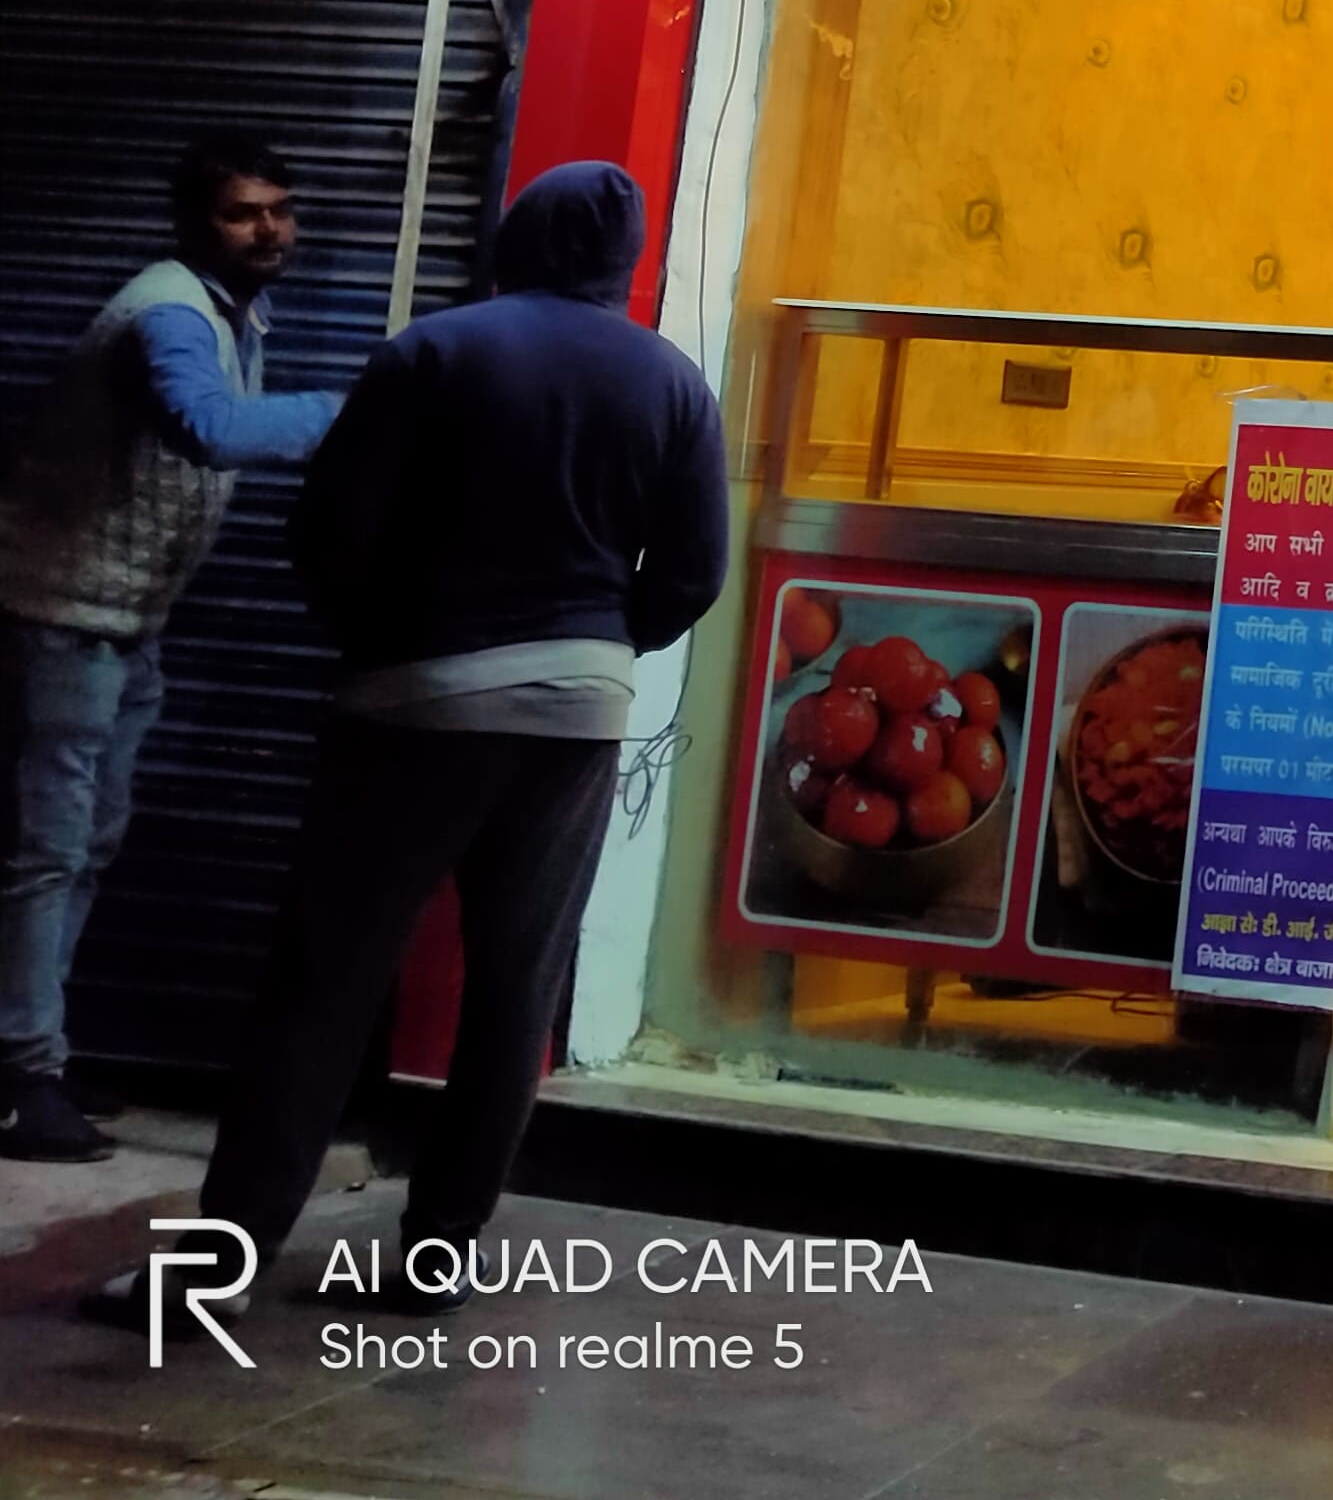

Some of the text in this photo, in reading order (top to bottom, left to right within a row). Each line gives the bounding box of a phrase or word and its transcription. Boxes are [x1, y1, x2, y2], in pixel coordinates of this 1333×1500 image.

[1247, 450, 1304, 505] कोरोना
[1245, 533, 1277, 553] आप
[1289, 530, 1324, 556] सभी
[1240, 571, 1281, 601] आदि
[1296, 580, 1311, 599] व
[1235, 615, 1309, 644] परिस्थिति
[1230, 661, 1304, 690] सामाजिक
[1225, 703, 1243, 730] के
[1250, 705, 1298, 733] नियमों
[1278, 760, 1298, 779] 01
[1203, 821, 1247, 844] अन्यथा
[1258, 820, 1298, 849] आपके
[1197, 866, 1268, 896] (Criminal
[1201, 914, 1237, 934] आज्ञा
[1261, 912, 1282, 937] डी.
[1285, 916, 1320, 942] आई.
[1264, 951, 1293, 976] क्षेत्र
